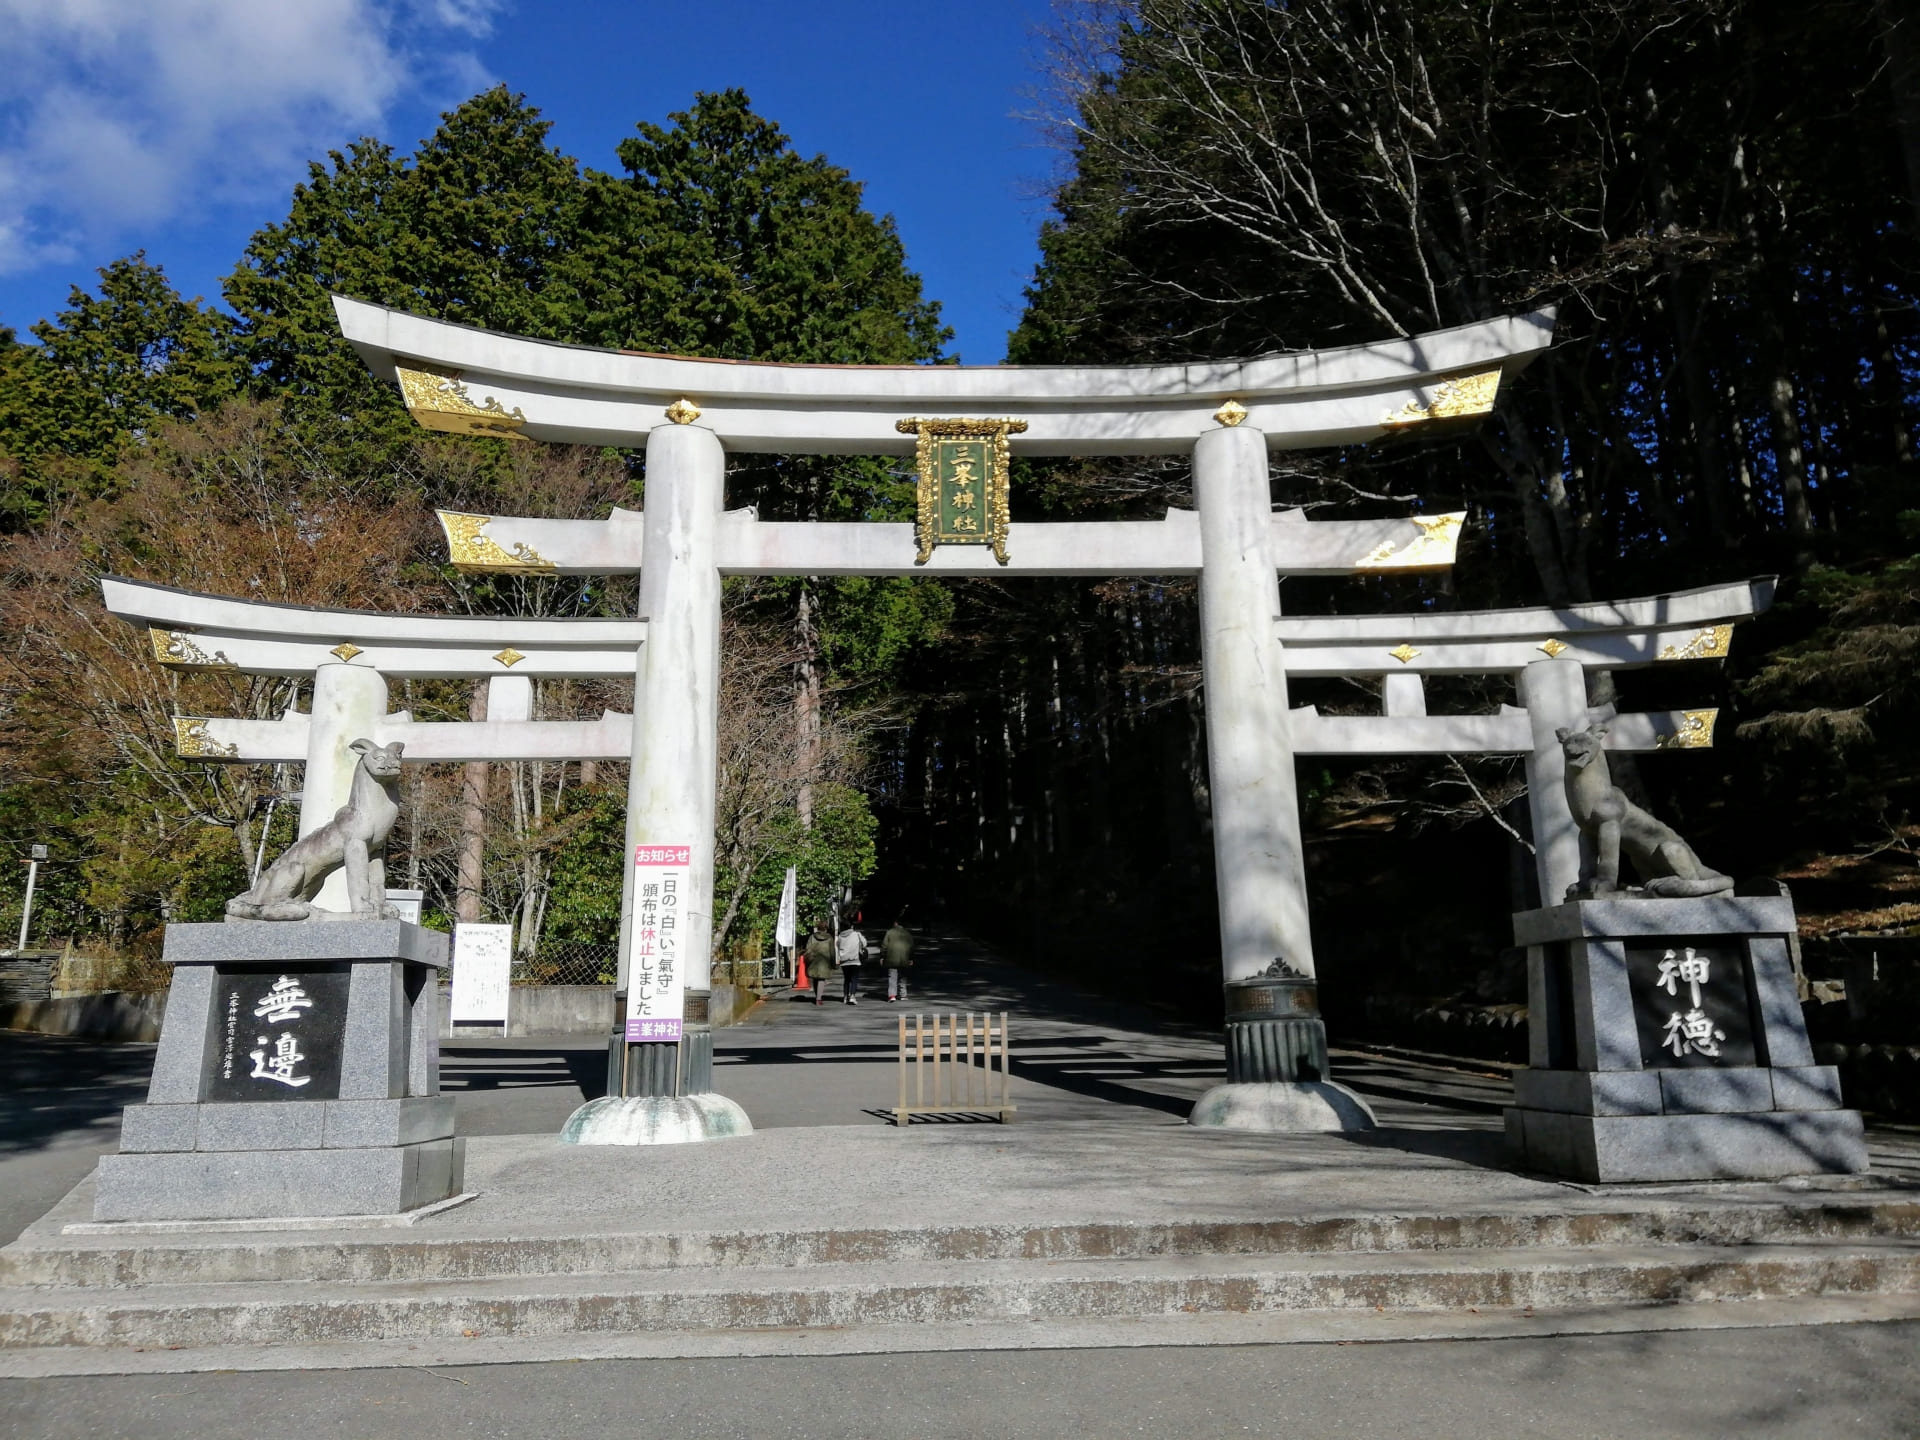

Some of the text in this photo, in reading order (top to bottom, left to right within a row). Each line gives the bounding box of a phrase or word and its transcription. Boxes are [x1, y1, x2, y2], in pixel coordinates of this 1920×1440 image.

[636, 849, 689, 863] お知らせ
[636, 883, 659, 1016] 頒布は休止しました
